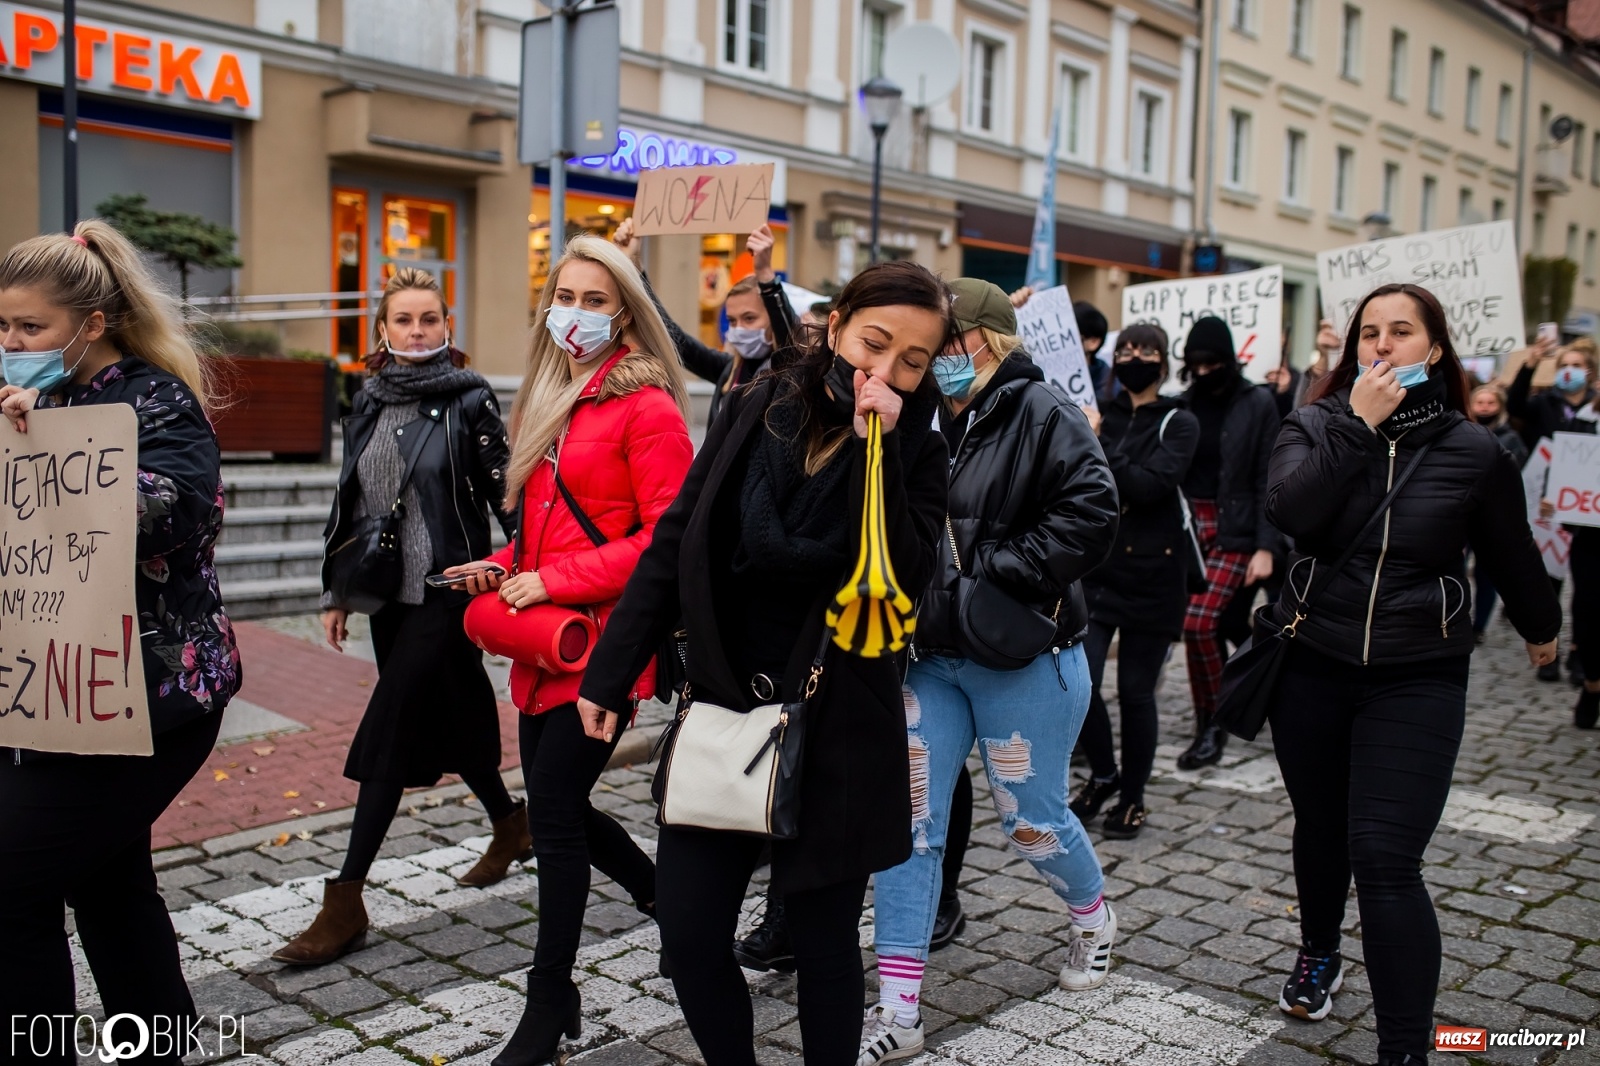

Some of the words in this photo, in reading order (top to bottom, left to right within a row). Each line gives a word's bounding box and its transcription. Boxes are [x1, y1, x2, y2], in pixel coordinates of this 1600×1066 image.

[0, 11, 251, 108] PTEKA
[1328, 243, 1392, 281] MARS
[1412, 257, 1479, 285] SRAM
[1207, 274, 1279, 306] PRECZ
[44, 615, 134, 724] NIE!
